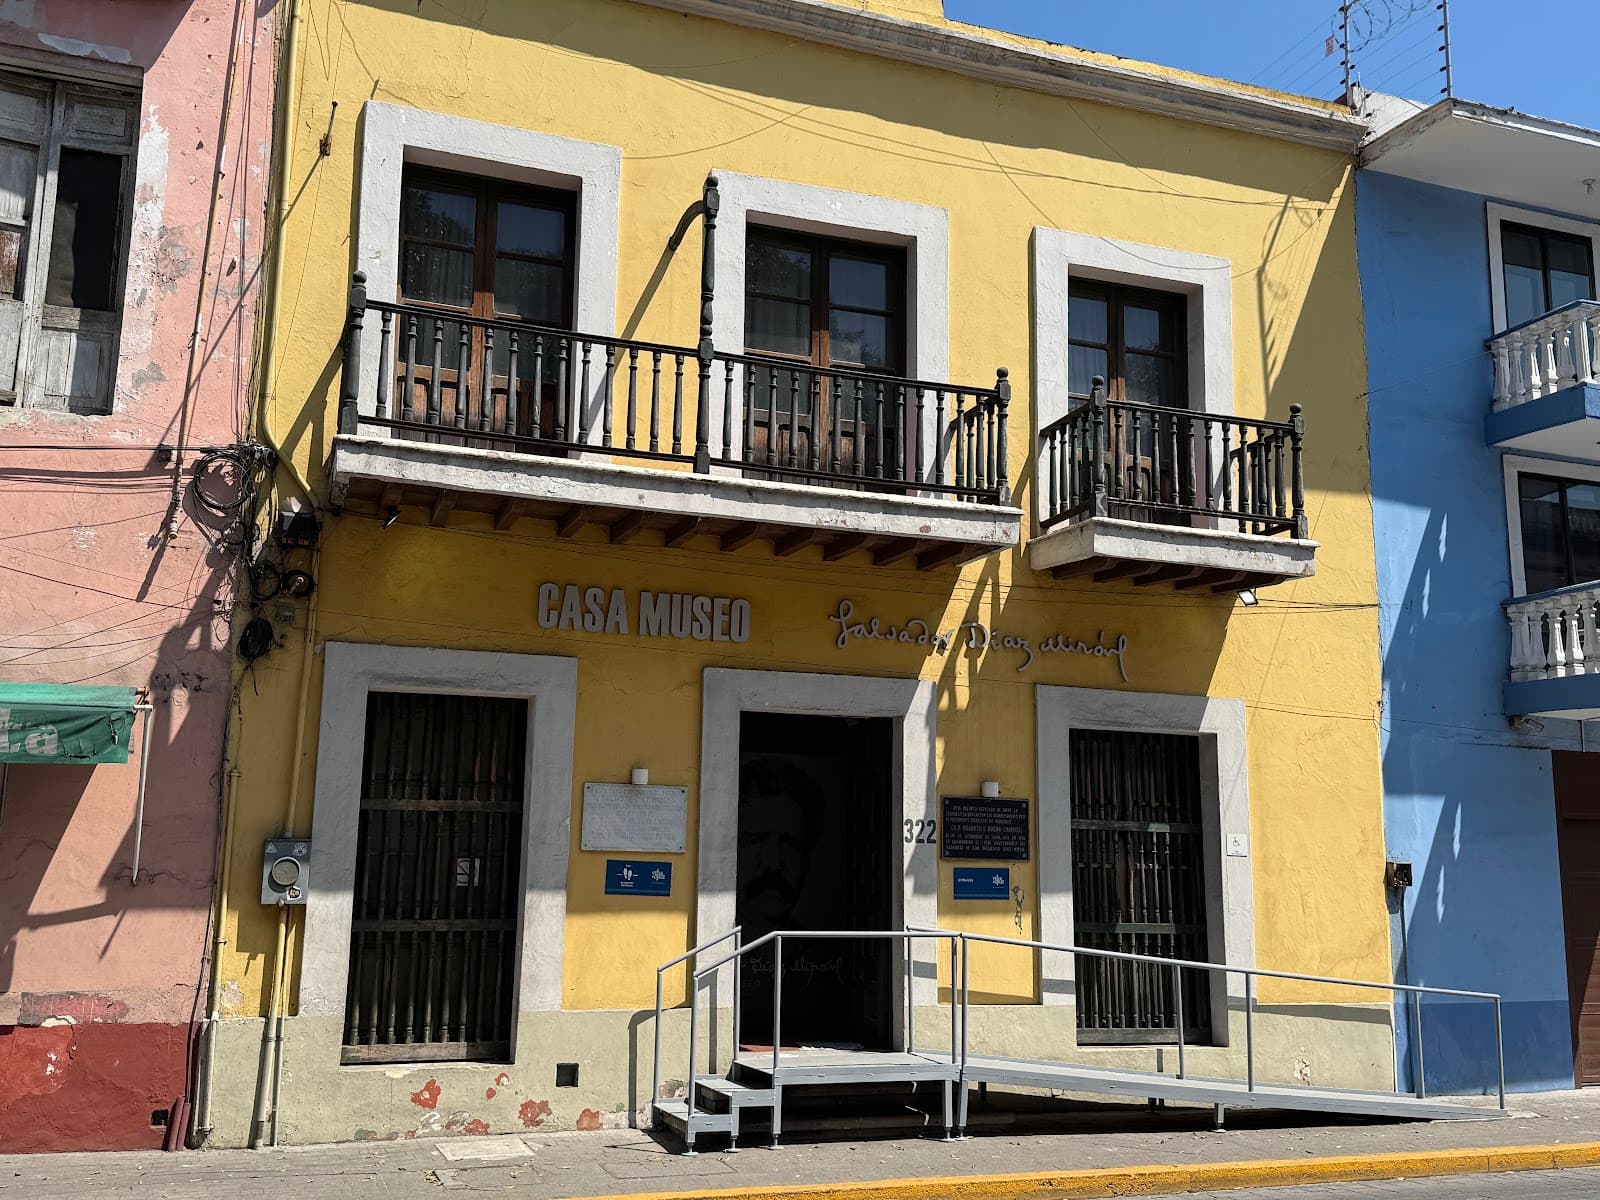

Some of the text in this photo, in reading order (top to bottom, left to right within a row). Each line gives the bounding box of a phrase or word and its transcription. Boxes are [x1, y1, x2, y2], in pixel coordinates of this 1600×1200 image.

[537, 583, 629, 635] CASA
[639, 590, 751, 643] MUSEO
[904, 818, 937, 844] 322
